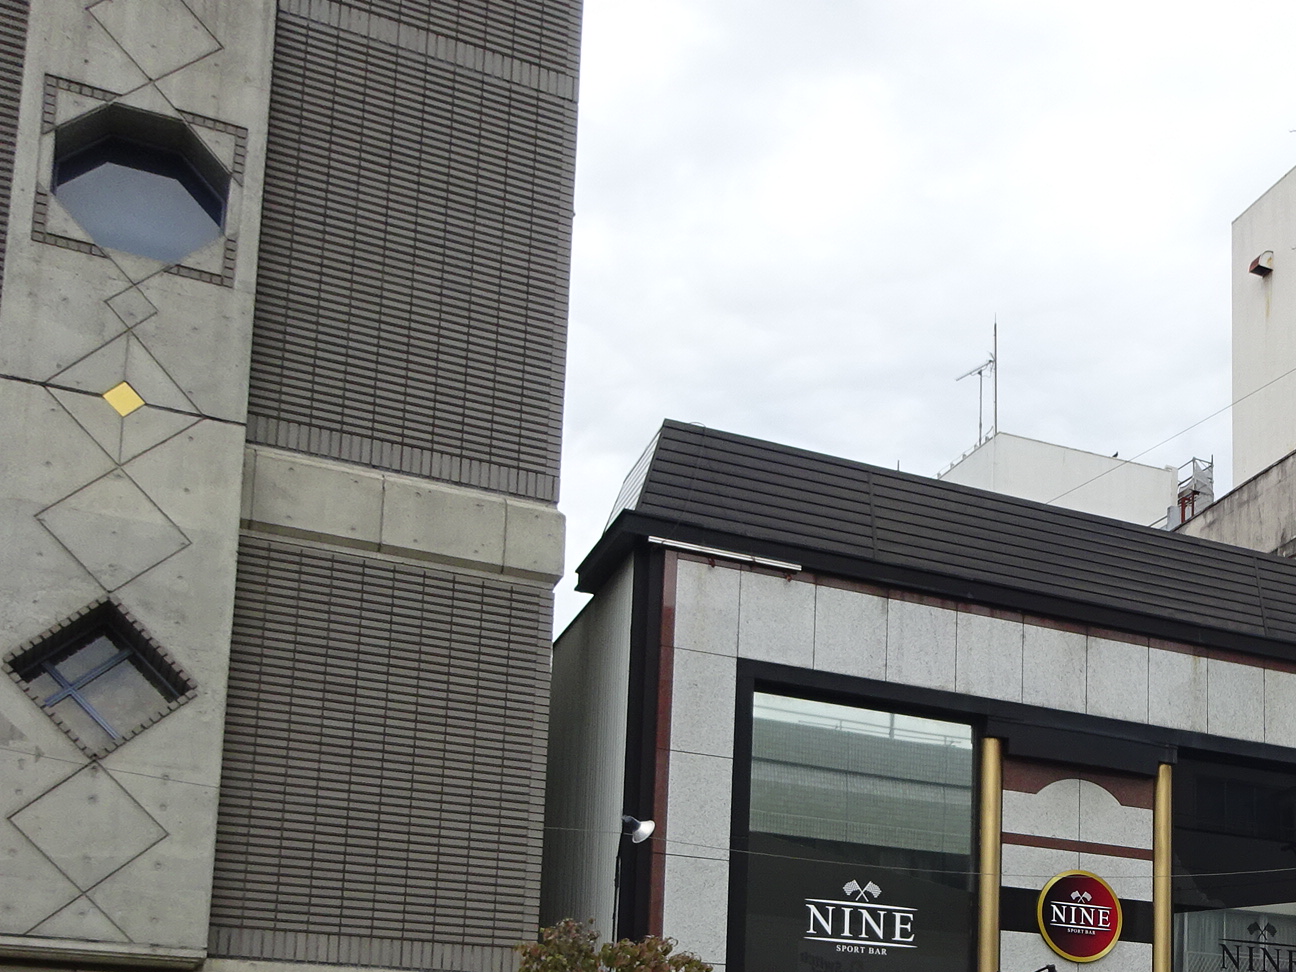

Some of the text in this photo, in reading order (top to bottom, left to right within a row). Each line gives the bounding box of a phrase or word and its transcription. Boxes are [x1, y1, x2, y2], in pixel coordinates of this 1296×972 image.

[805, 903, 916, 942] NINE
[1050, 904, 1111, 928] NINE
[836, 944, 888, 956] SPORT BAR
